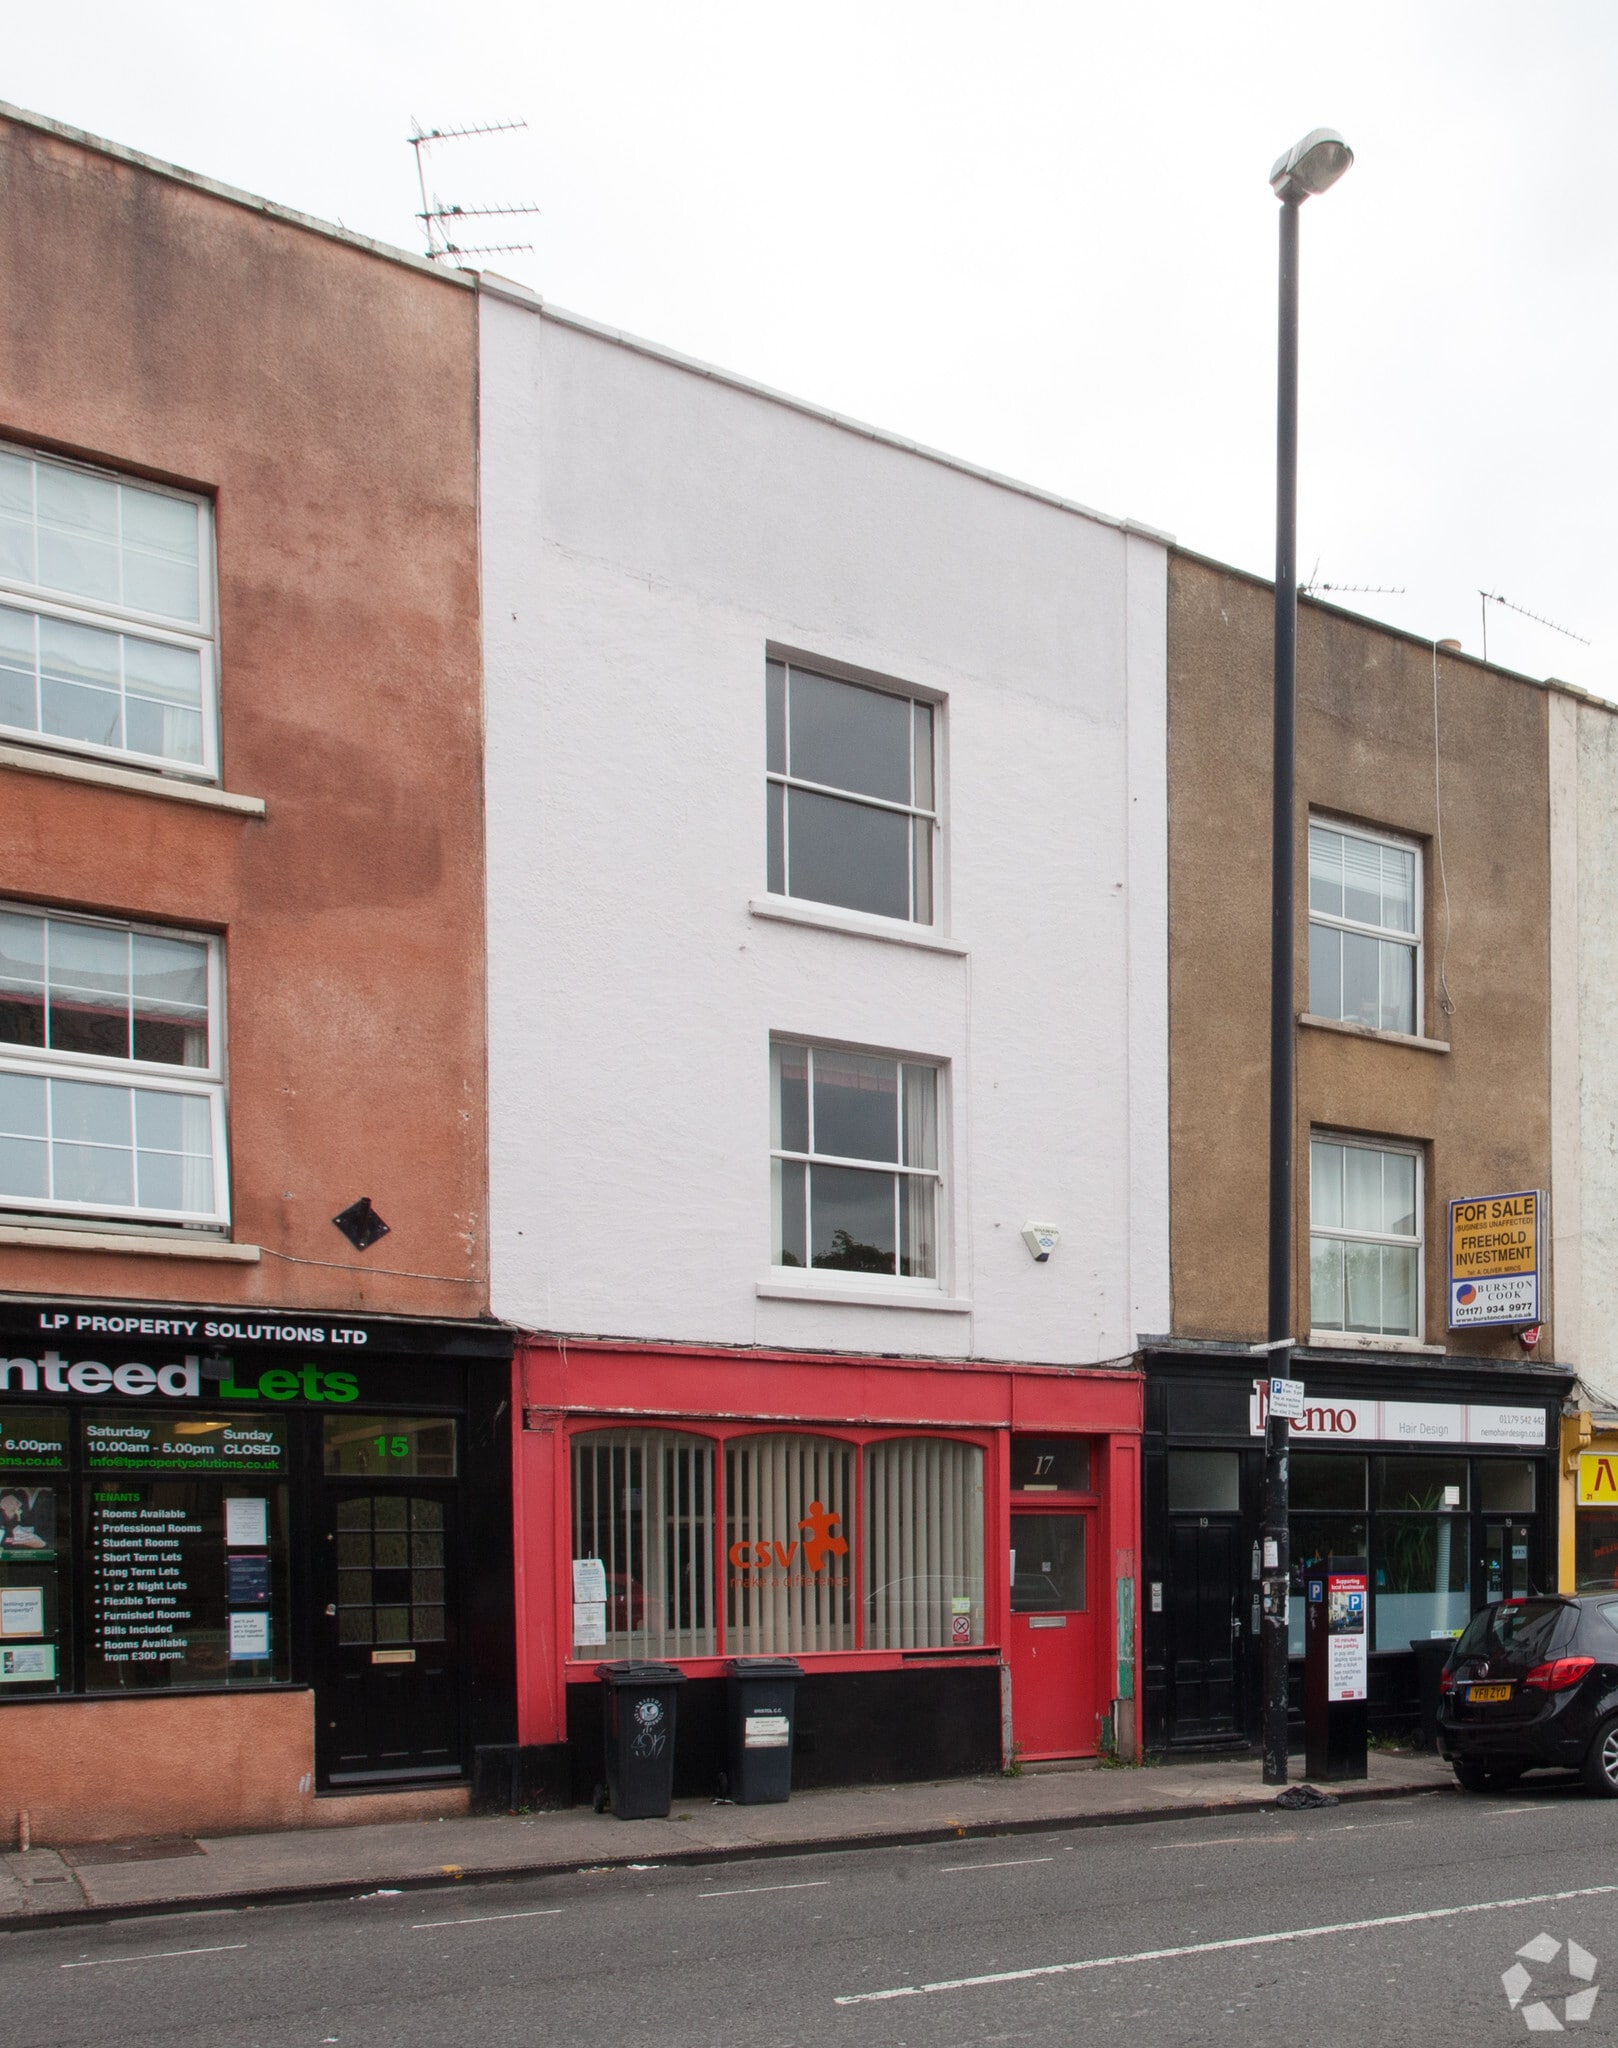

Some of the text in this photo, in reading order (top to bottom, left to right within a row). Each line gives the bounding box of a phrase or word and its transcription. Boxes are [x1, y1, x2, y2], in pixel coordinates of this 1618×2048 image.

[1456, 1198, 1533, 1223] FOR SALE
[1455, 1218, 1533, 1232] (BUSINESS UNAFFECTED)
[1461, 1231, 1526, 1249] FREEHOLD
[1456, 1246, 1531, 1266] INVESTMENT
[1478, 1280, 1532, 1293] BURSTON
[1488, 1291, 1521, 1300] COOK
[1456, 1303, 1532, 1316] (0117) 934 9977
[1456, 1313, 1532, 1322] www.burstoncook.co.uk
[40, 1313, 368, 1344] LP PROPERTY SOLUTIONS LTD
[219, 1356, 359, 1402] Lets
[1500, 1415, 1544, 1425] 01179 542 442
[87, 1426, 273, 1442] Saturday Sunday
[1399, 1422, 1449, 1437] Hair Design
[1481, 1429, 1544, 1439] nemohairdesign.co.uk
[5, 1439, 62, 1452] 6.00pm
[88, 1441, 149, 1453] 10.00am
[162, 1443, 214, 1455] 5.00pm
[223, 1444, 281, 1455] CLOSED
[372, 1436, 409, 1457] 15
[89, 1457, 279, 1469] info@lppropertysolutions.co.uk
[1033, 1456, 1054, 1476] 17
[94, 1493, 140, 1502] TENANTS
[102, 1509, 186, 1518] Rooms Available
[1200, 1517, 1209, 1528] 19
[102, 1524, 202, 1533] Professional Rooms
[103, 1539, 179, 1547] Student Rooms
[1253, 1539, 1259, 1550] A
[103, 1553, 182, 1562] Short Term Lets
[103, 1567, 180, 1578] Long Term Lets
[730, 1576, 767, 1587] make
[783, 1575, 849, 1587] difference
[104, 1583, 109, 1591] 1
[127, 1582, 134, 1591] 2
[137, 1582, 164, 1592] Night
[166, 1582, 187, 1590] Lets
[1313, 1584, 1320, 1598] P
[104, 1596, 176, 1606] Flexible Terms
[1253, 1594, 1259, 1604] B
[104, 1610, 191, 1620] Furnished Rooms
[104, 1624, 173, 1635] Bills Included
[104, 1639, 188, 1649] Rooms Available
[104, 1652, 184, 1661] from £300 pcm.
